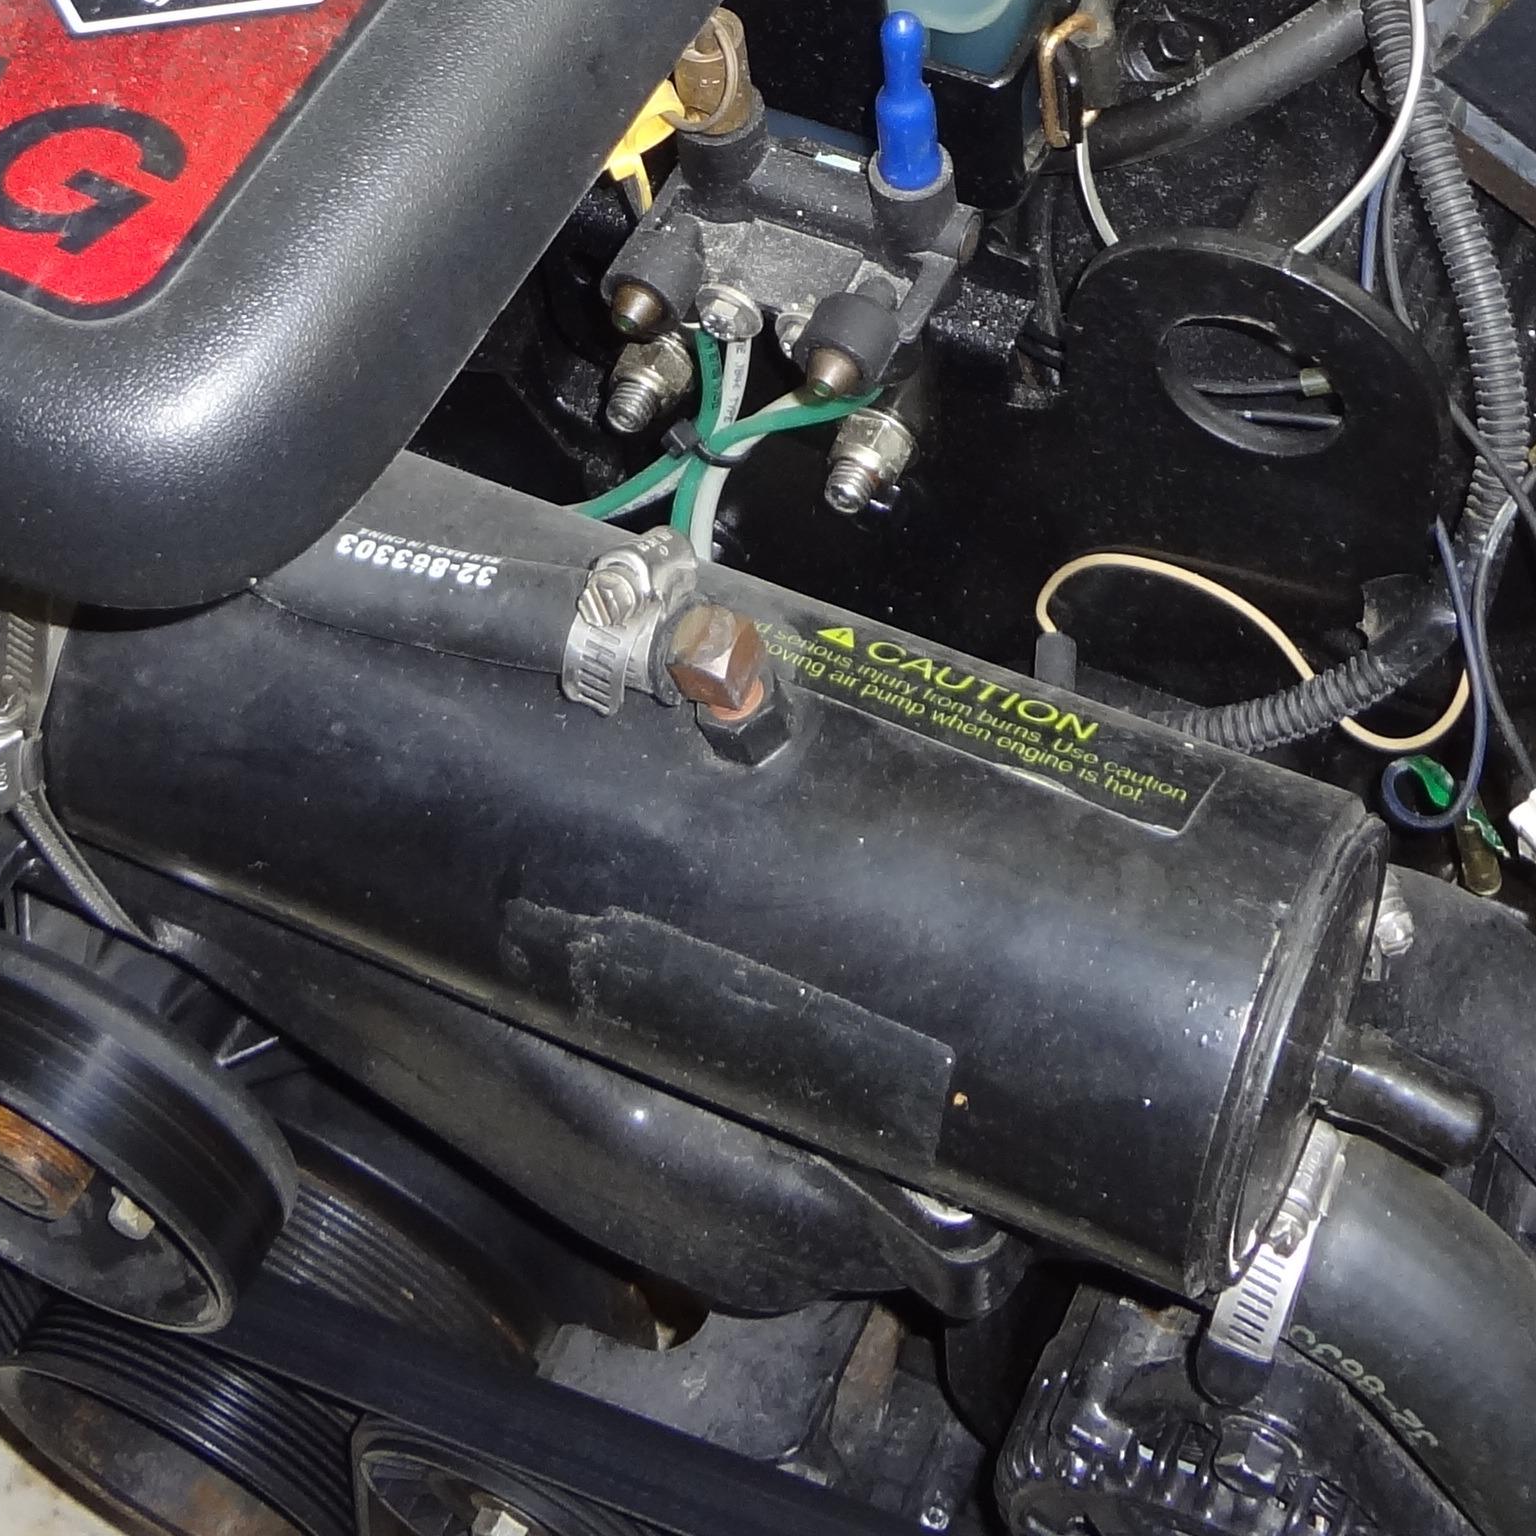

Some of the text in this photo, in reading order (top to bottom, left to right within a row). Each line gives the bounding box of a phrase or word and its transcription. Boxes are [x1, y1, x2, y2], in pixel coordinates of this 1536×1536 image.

[1150, 62, 1218, 104] Parker
[721, 396, 741, 424] TYPE
[761, 635, 825, 678] oving
[829, 668, 859, 690] air
[860, 683, 927, 718] pump
[931, 709, 992, 743] when
[996, 733, 1075, 774] engine
[1077, 766, 1098, 783] is
[774, 626, 853, 668] serious
[858, 663, 919, 698] injury
[921, 685, 974, 714] from
[1051, 737, 1099, 765] Use
[1103, 759, 1188, 803] caution
[868, 640, 1099, 740] CAUTION
